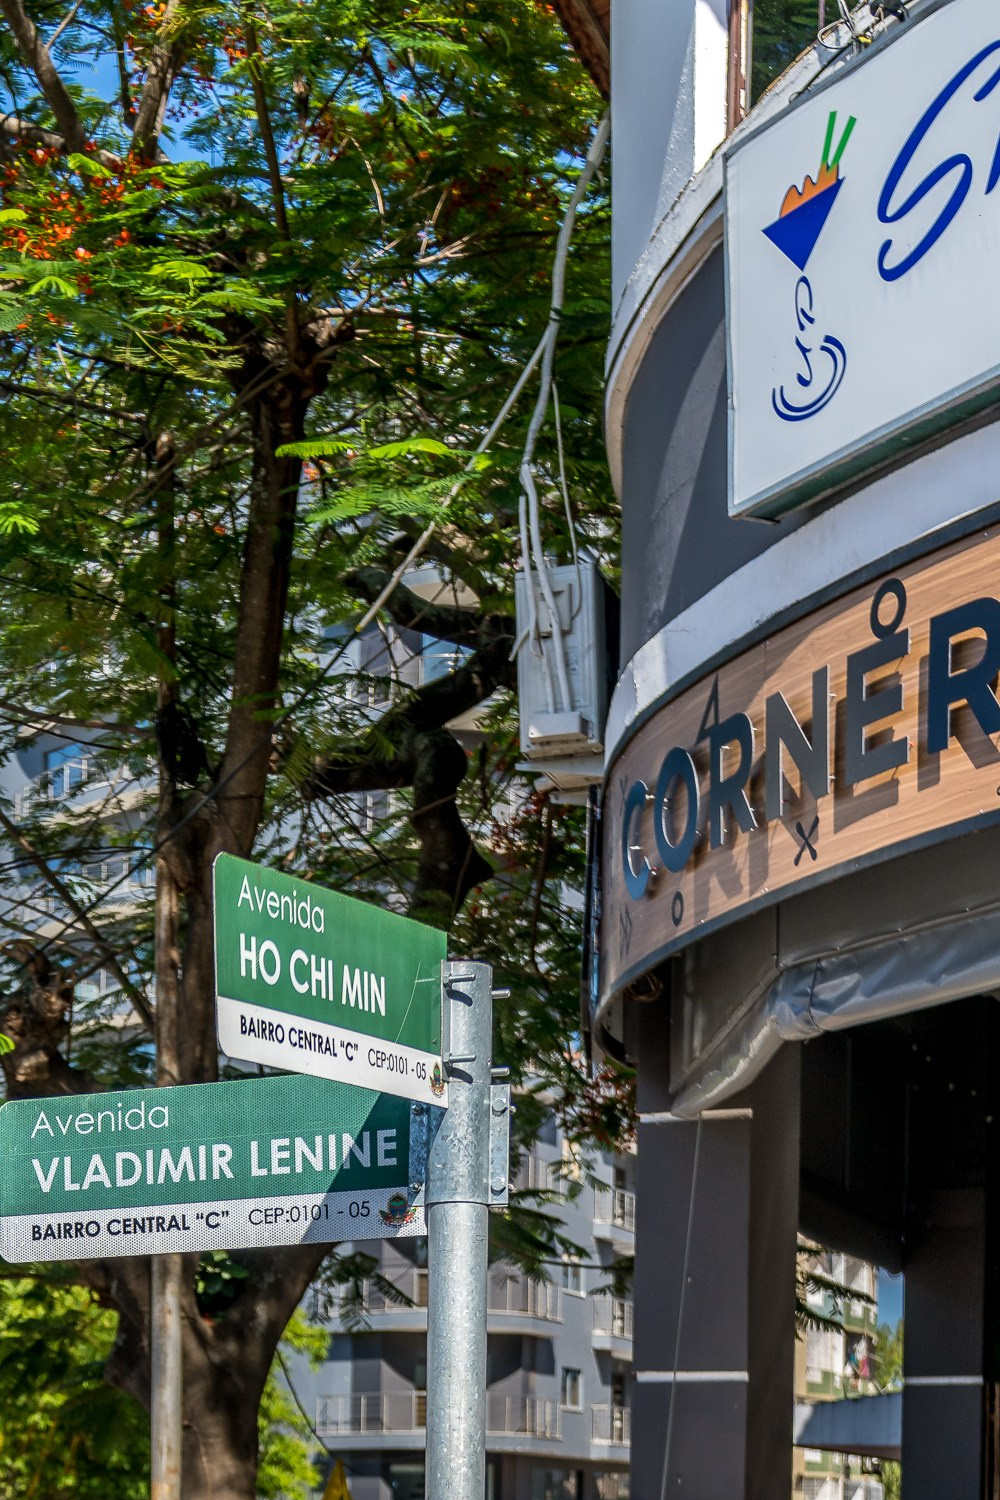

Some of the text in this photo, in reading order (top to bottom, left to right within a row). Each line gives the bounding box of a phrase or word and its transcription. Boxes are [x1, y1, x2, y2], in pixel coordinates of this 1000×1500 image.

[622, 596, 1000, 900] CORNER
[238, 874, 325, 934] Avenida
[239, 932, 386, 1017] HO CHI MIN
[240, 1014, 285, 1044] BAIRRO
[288, 1029, 337, 1058] CENTRAL
[368, 1048, 408, 1076] CEP:0101
[416, 1061, 427, 1081] 05
[31, 1102, 170, 1139] Avenida
[31, 1128, 398, 1193] VLADIMIR LENINE
[31, 1220, 101, 1241] BAIRRO
[107, 1214, 190, 1236] CENTRAL
[248, 1203, 330, 1226] CEP:0101
[348, 1200, 371, 1219] 05
